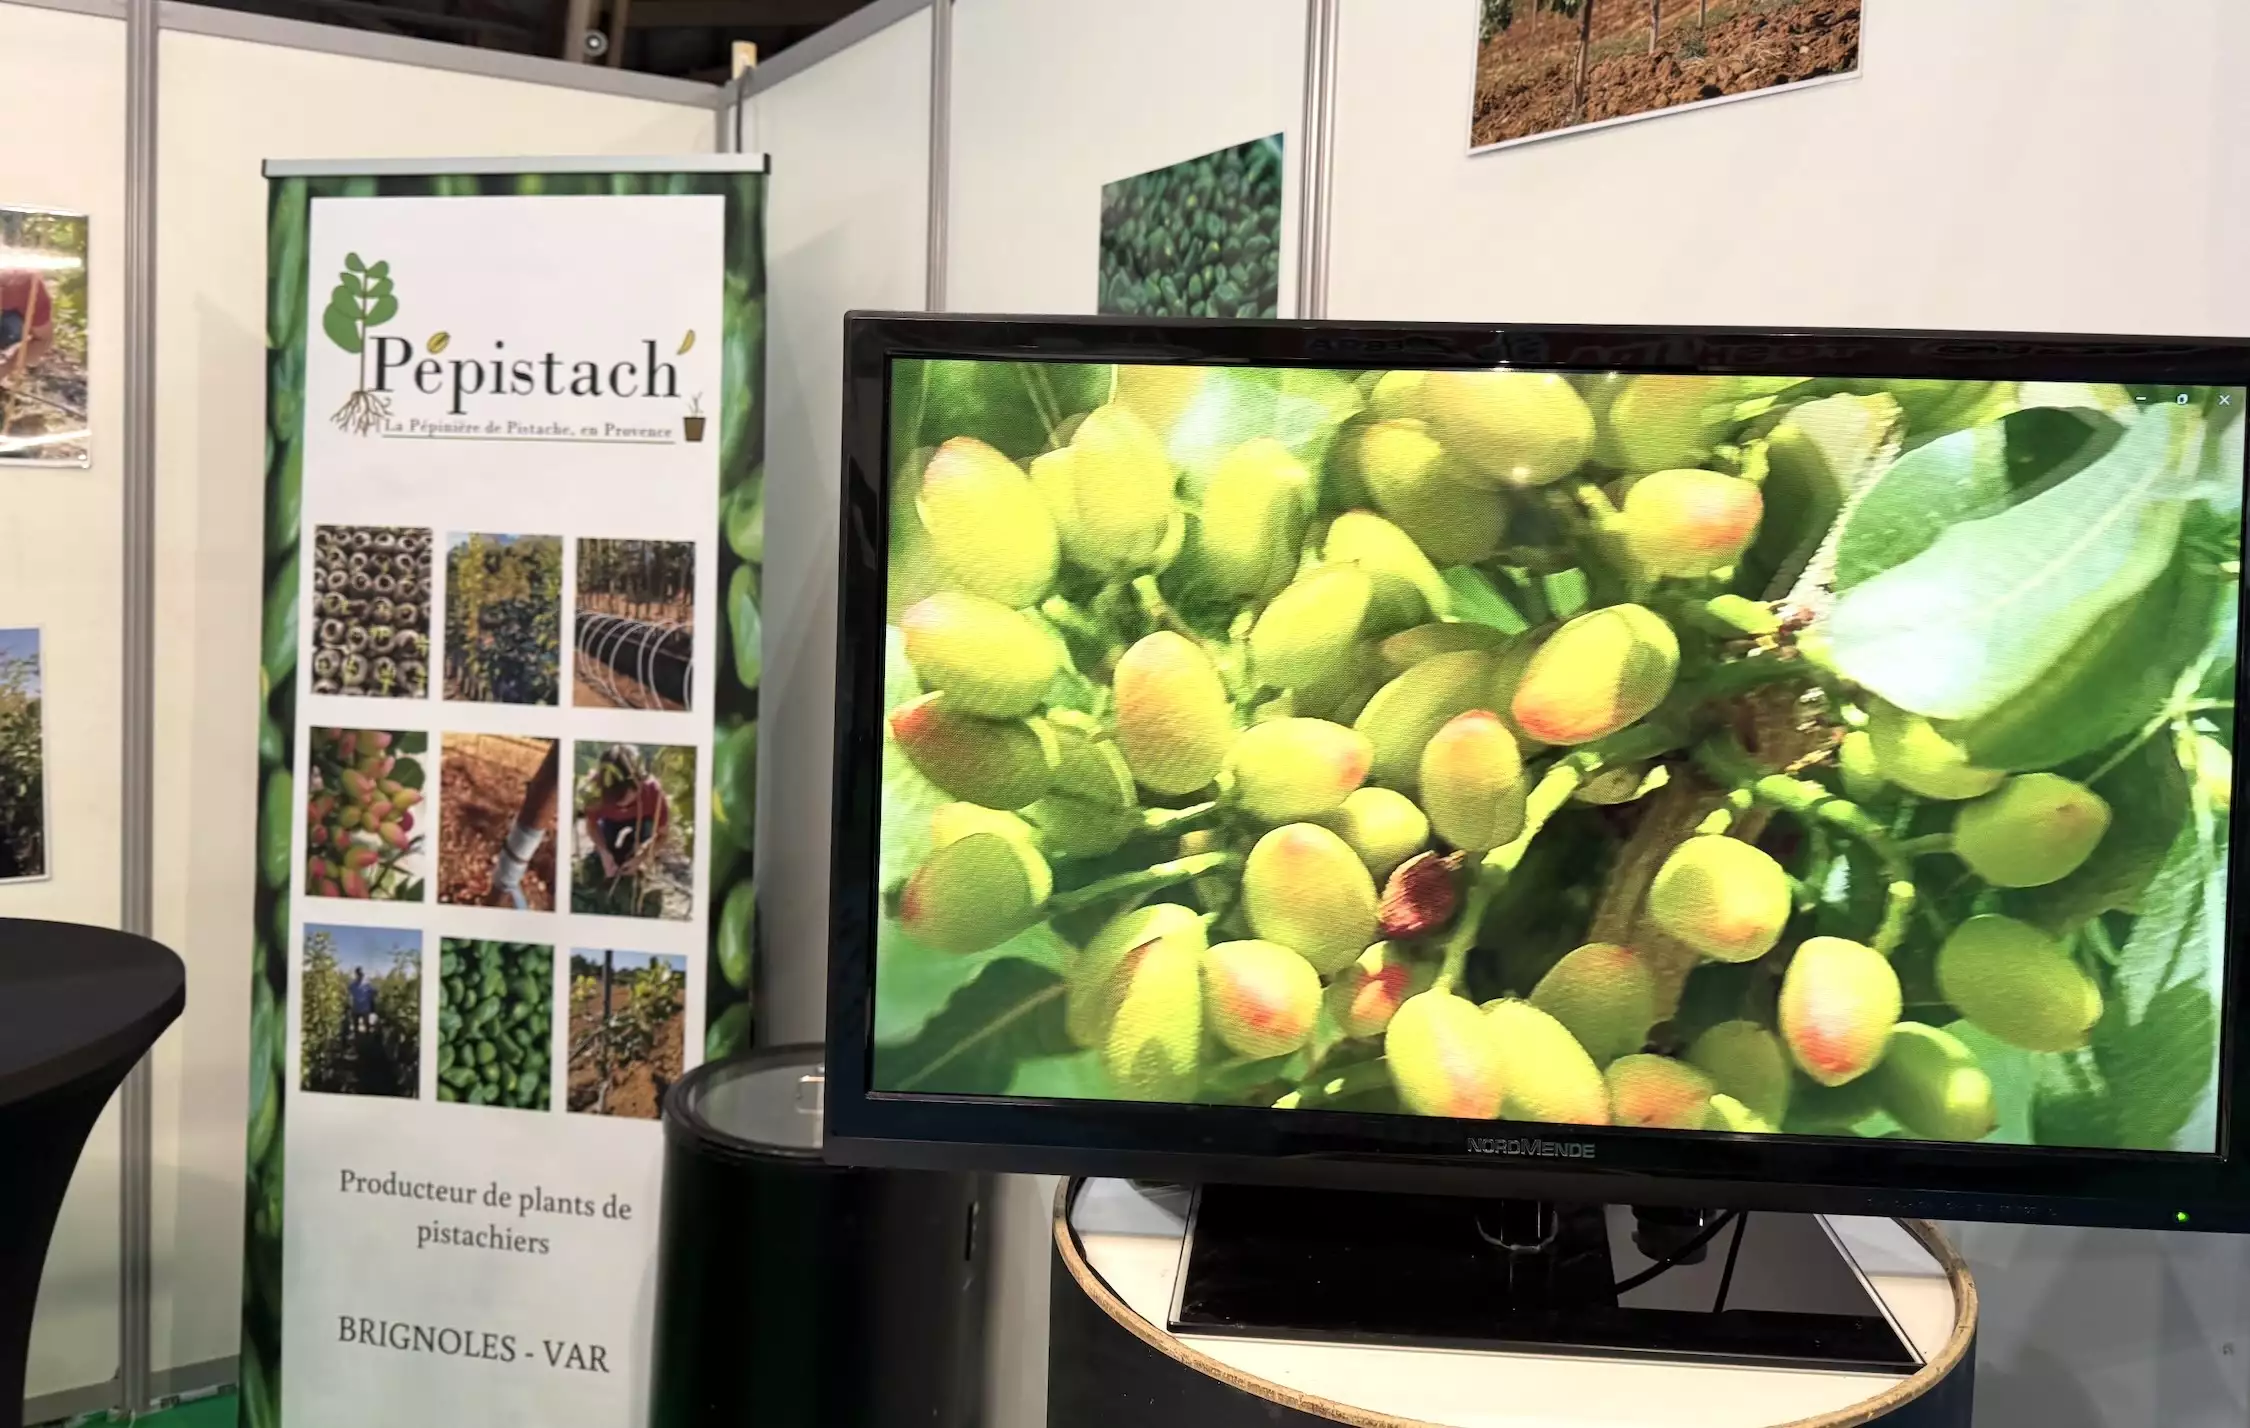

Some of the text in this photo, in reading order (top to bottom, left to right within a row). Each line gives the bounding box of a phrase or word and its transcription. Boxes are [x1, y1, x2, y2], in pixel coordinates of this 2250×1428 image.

[385, 418, 404, 432] La
[410, 418, 481, 438] Pépinière
[484, 420, 502, 434] de
[580, 427, 598, 436] en
[604, 422, 672, 438] Provence
[339, 1169, 632, 1220] Producteur de plants de
[416, 1220, 551, 1254] pistachiers
[337, 1315, 517, 1363] BRIGNOLES
[542, 1339, 611, 1374] VAR
